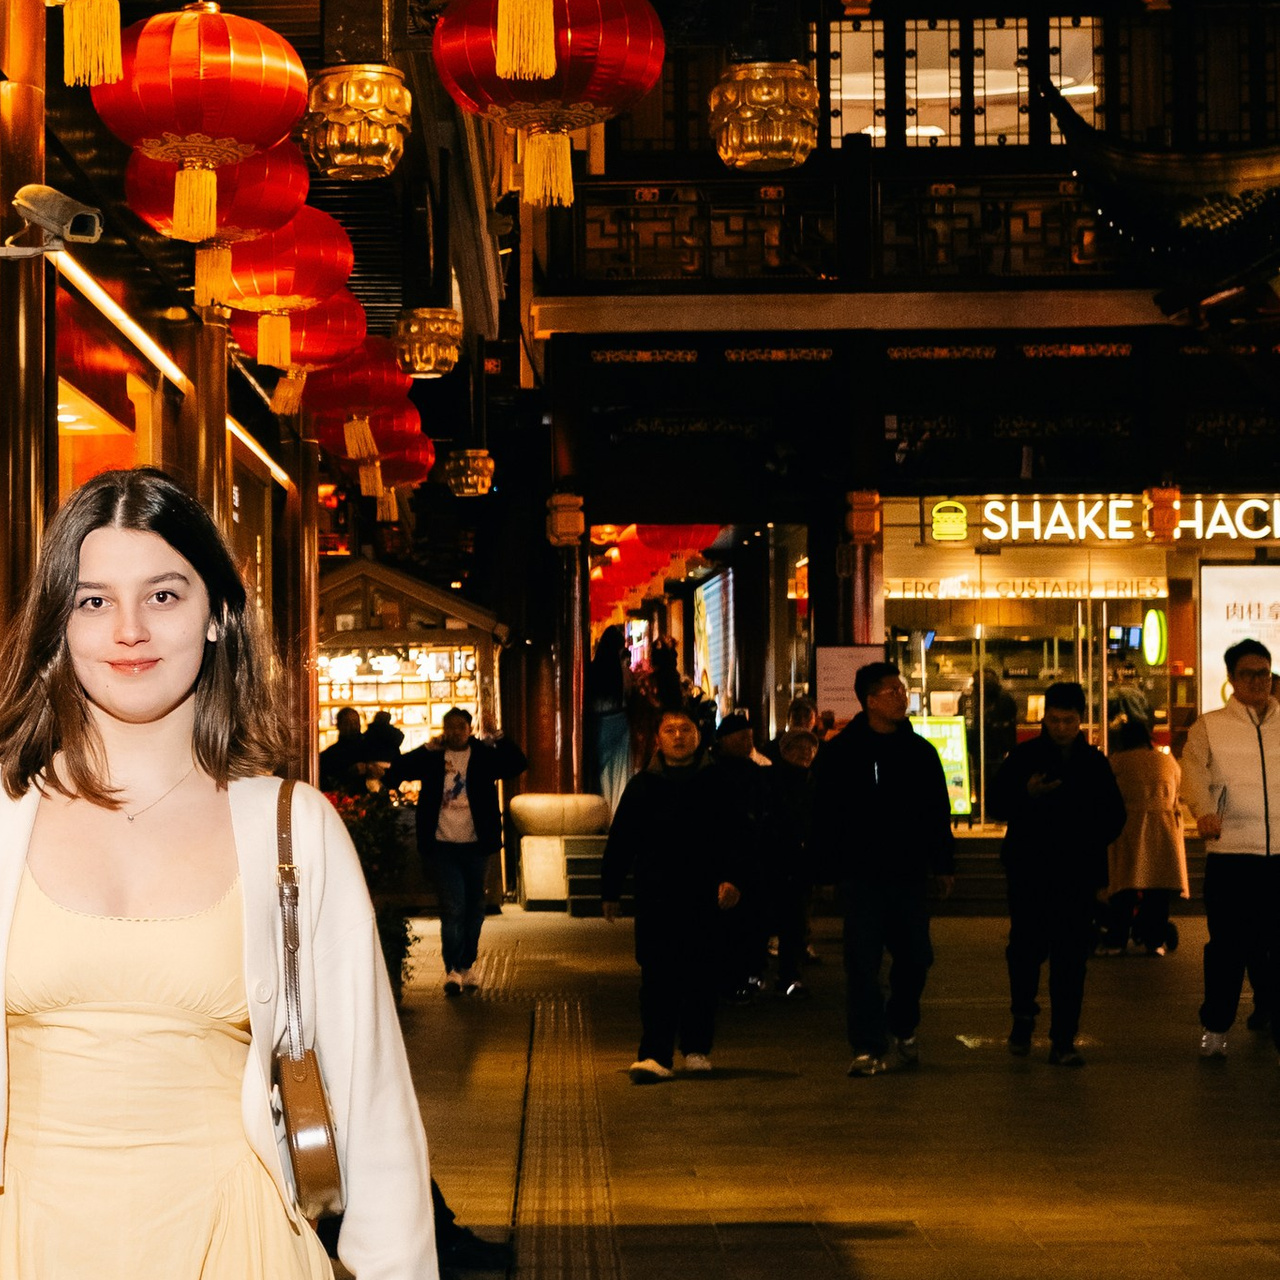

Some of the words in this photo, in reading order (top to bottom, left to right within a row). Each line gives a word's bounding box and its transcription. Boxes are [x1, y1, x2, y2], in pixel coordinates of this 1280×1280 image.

[982, 500, 1135, 540] SHAKE
[1148, 499, 1280, 540] HAC
[996, 580, 1093, 598] CUSTARD
[1104, 578, 1160, 598] FRIES
